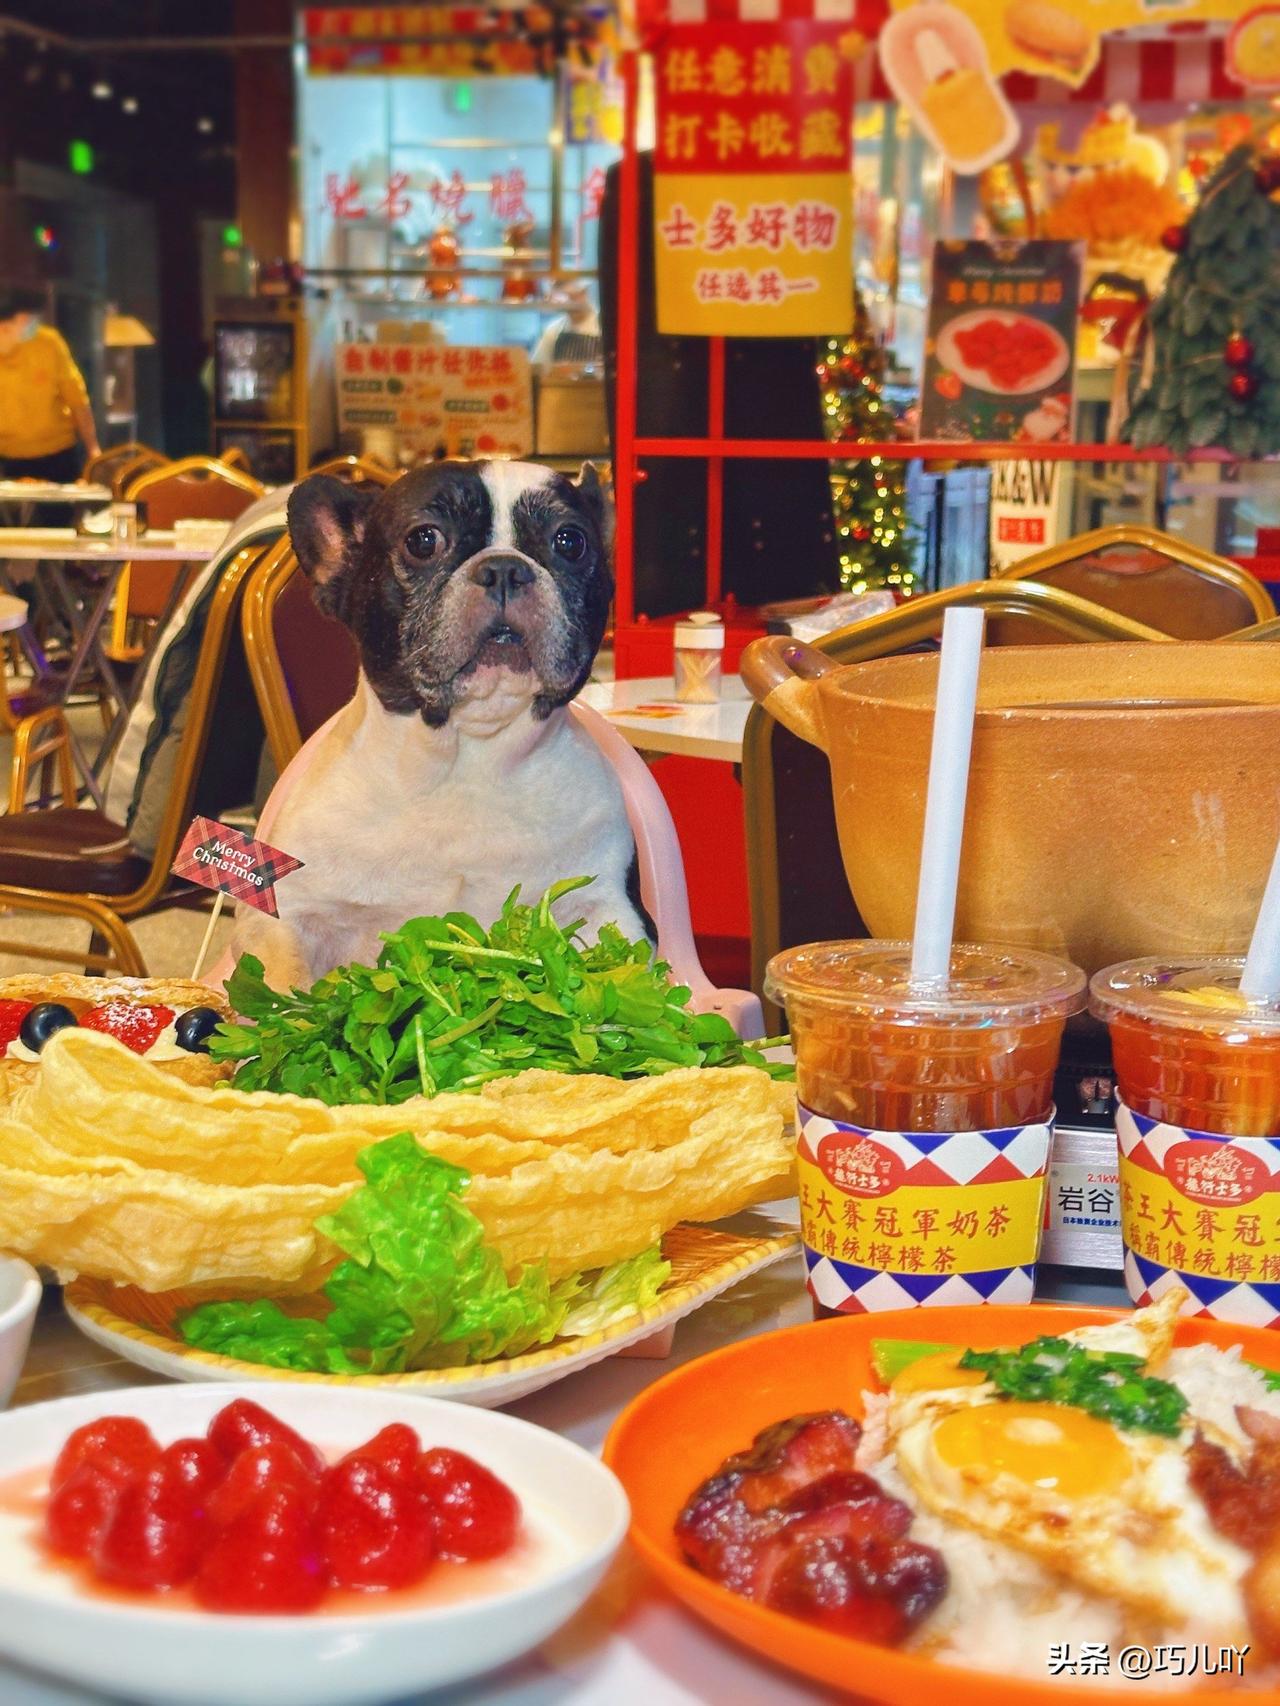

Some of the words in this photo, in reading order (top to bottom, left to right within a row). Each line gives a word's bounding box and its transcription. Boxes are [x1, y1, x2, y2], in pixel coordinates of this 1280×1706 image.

[664, 109, 845, 160] 打卡收藏
[661, 203, 838, 251] 士多好物
[698, 270, 817, 301] 任选其一
[192, 847, 264, 886] Christmas
[211, 841, 256, 867] Merry
[1058, 1185, 1114, 1213] 岩谷
